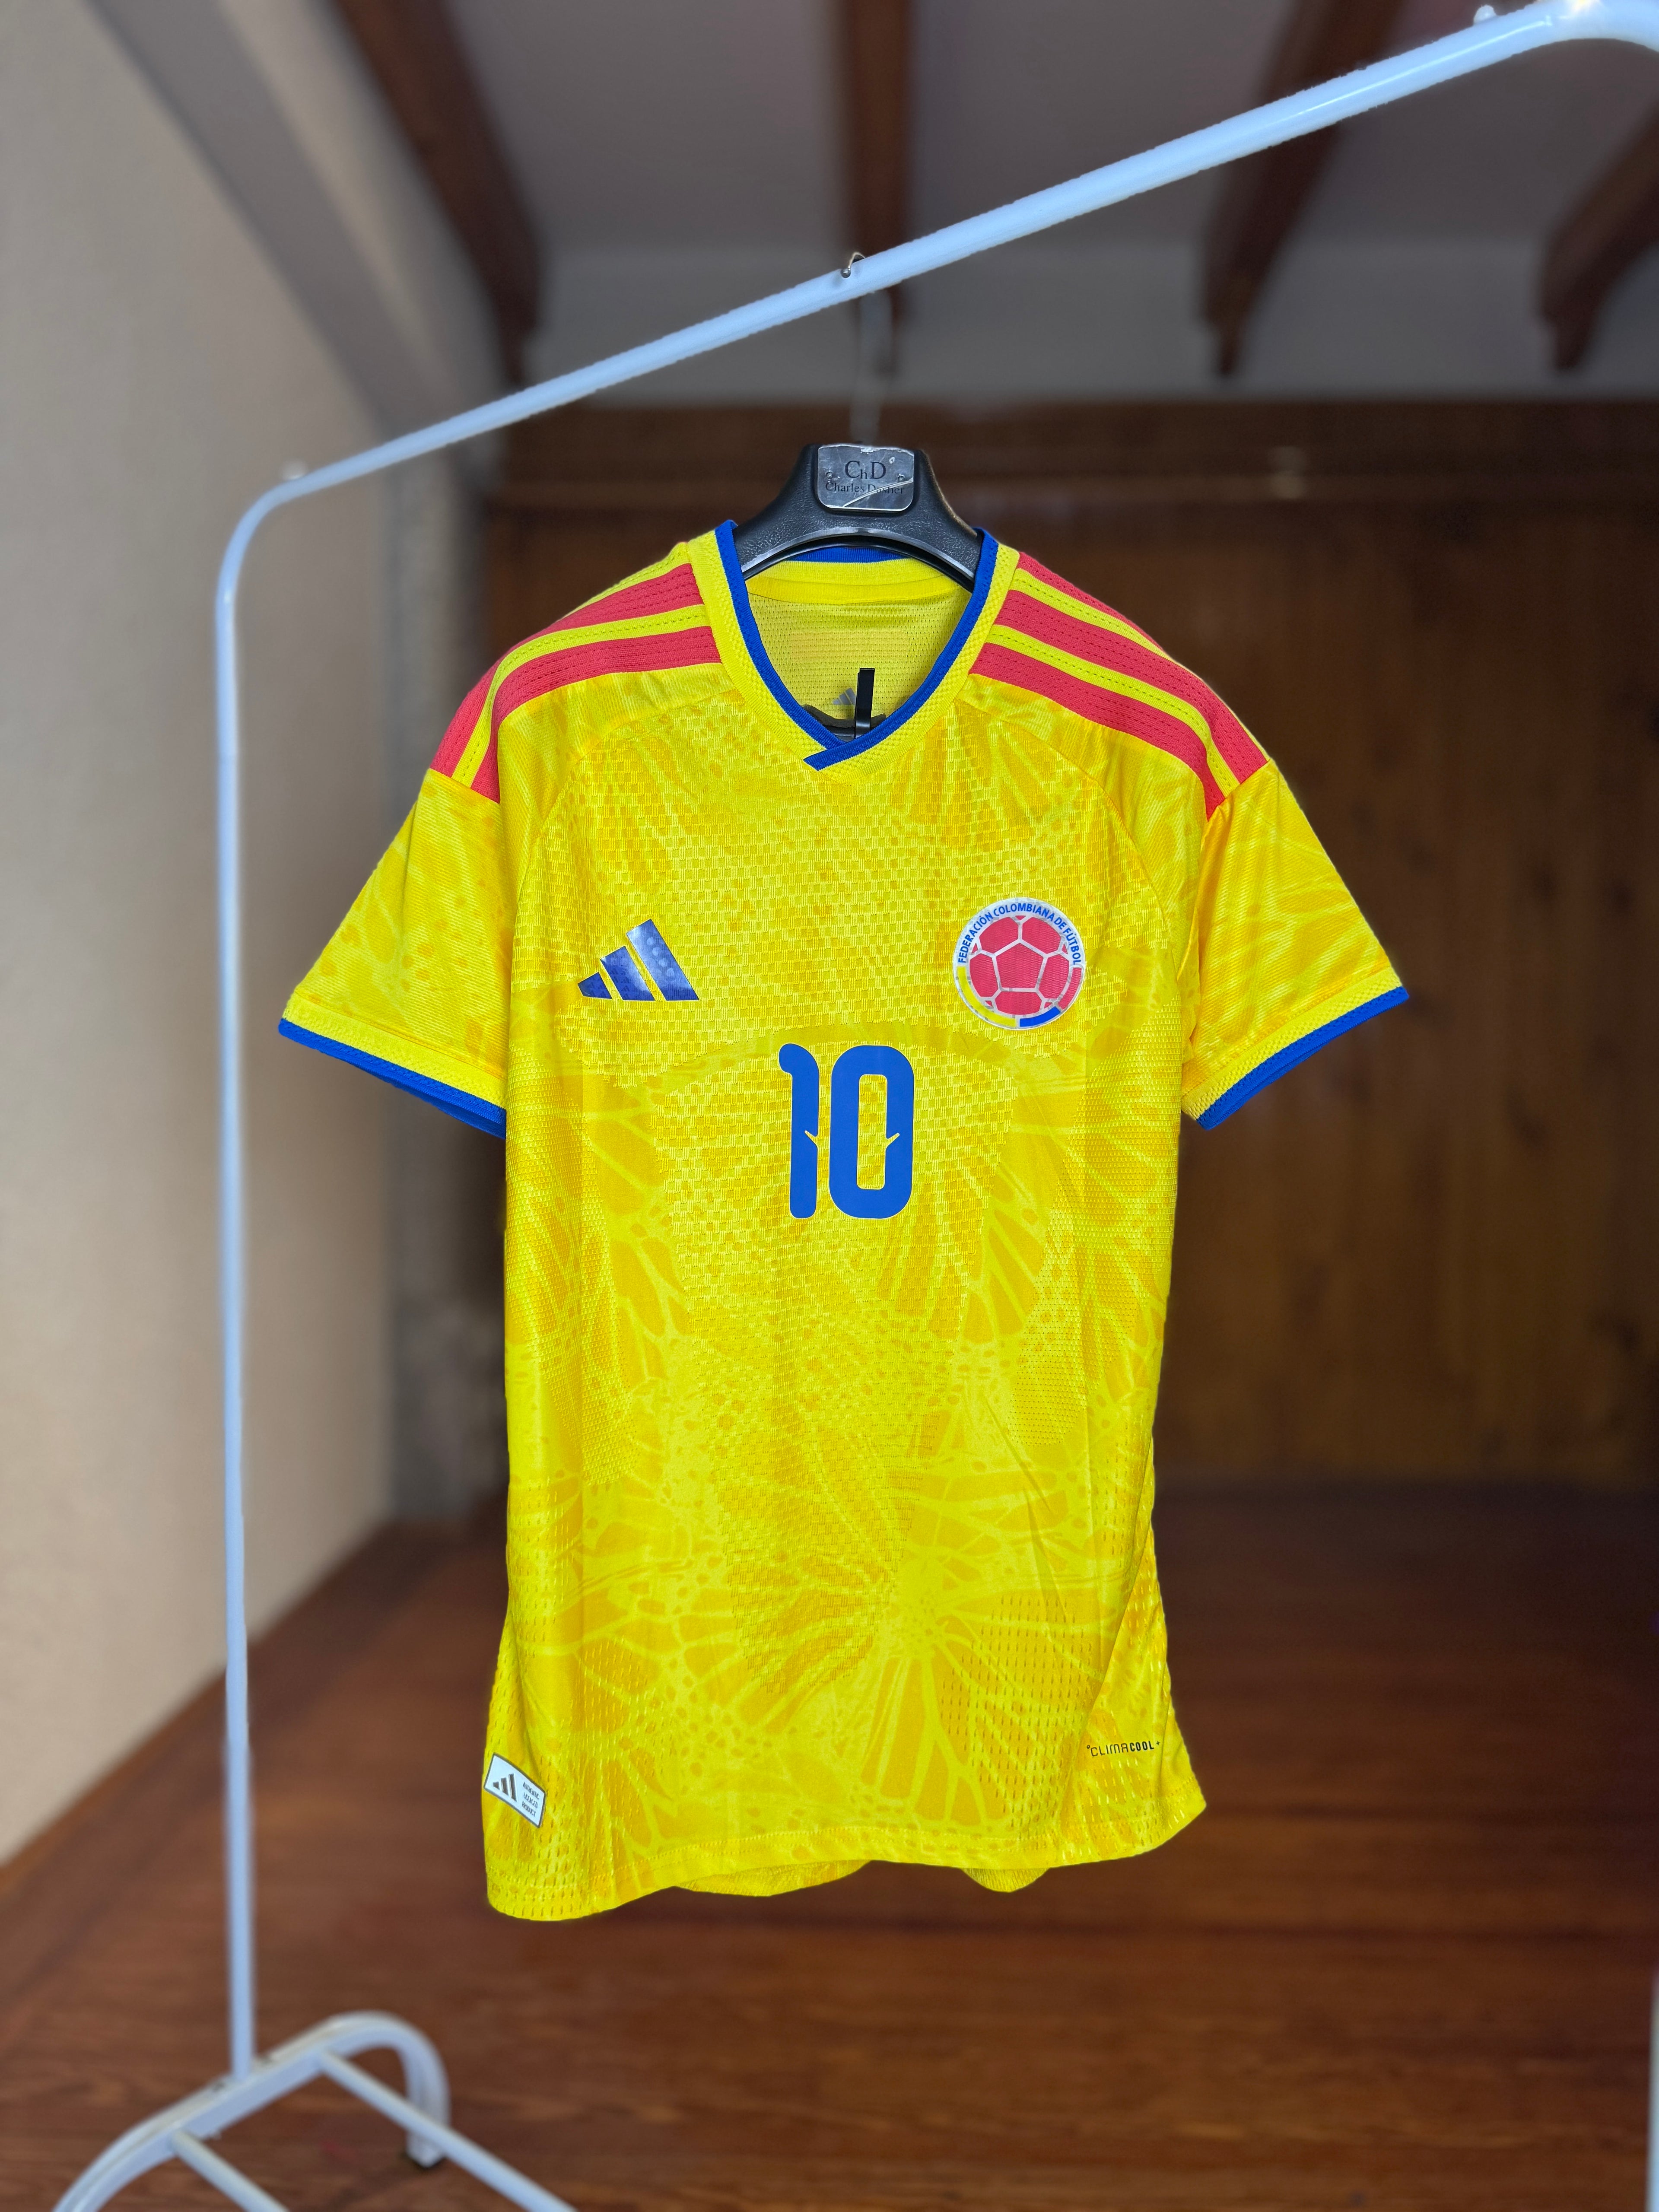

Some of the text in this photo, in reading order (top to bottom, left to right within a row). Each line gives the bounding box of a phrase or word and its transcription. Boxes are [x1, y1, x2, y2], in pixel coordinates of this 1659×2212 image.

[825, 482, 864, 493] Charles
[845, 460, 886, 479] ChD
[958, 903, 1082, 965] FEDERACIÓN COLOMBIANA DE FÚTBOL
[778, 1043, 915, 1219] 10
